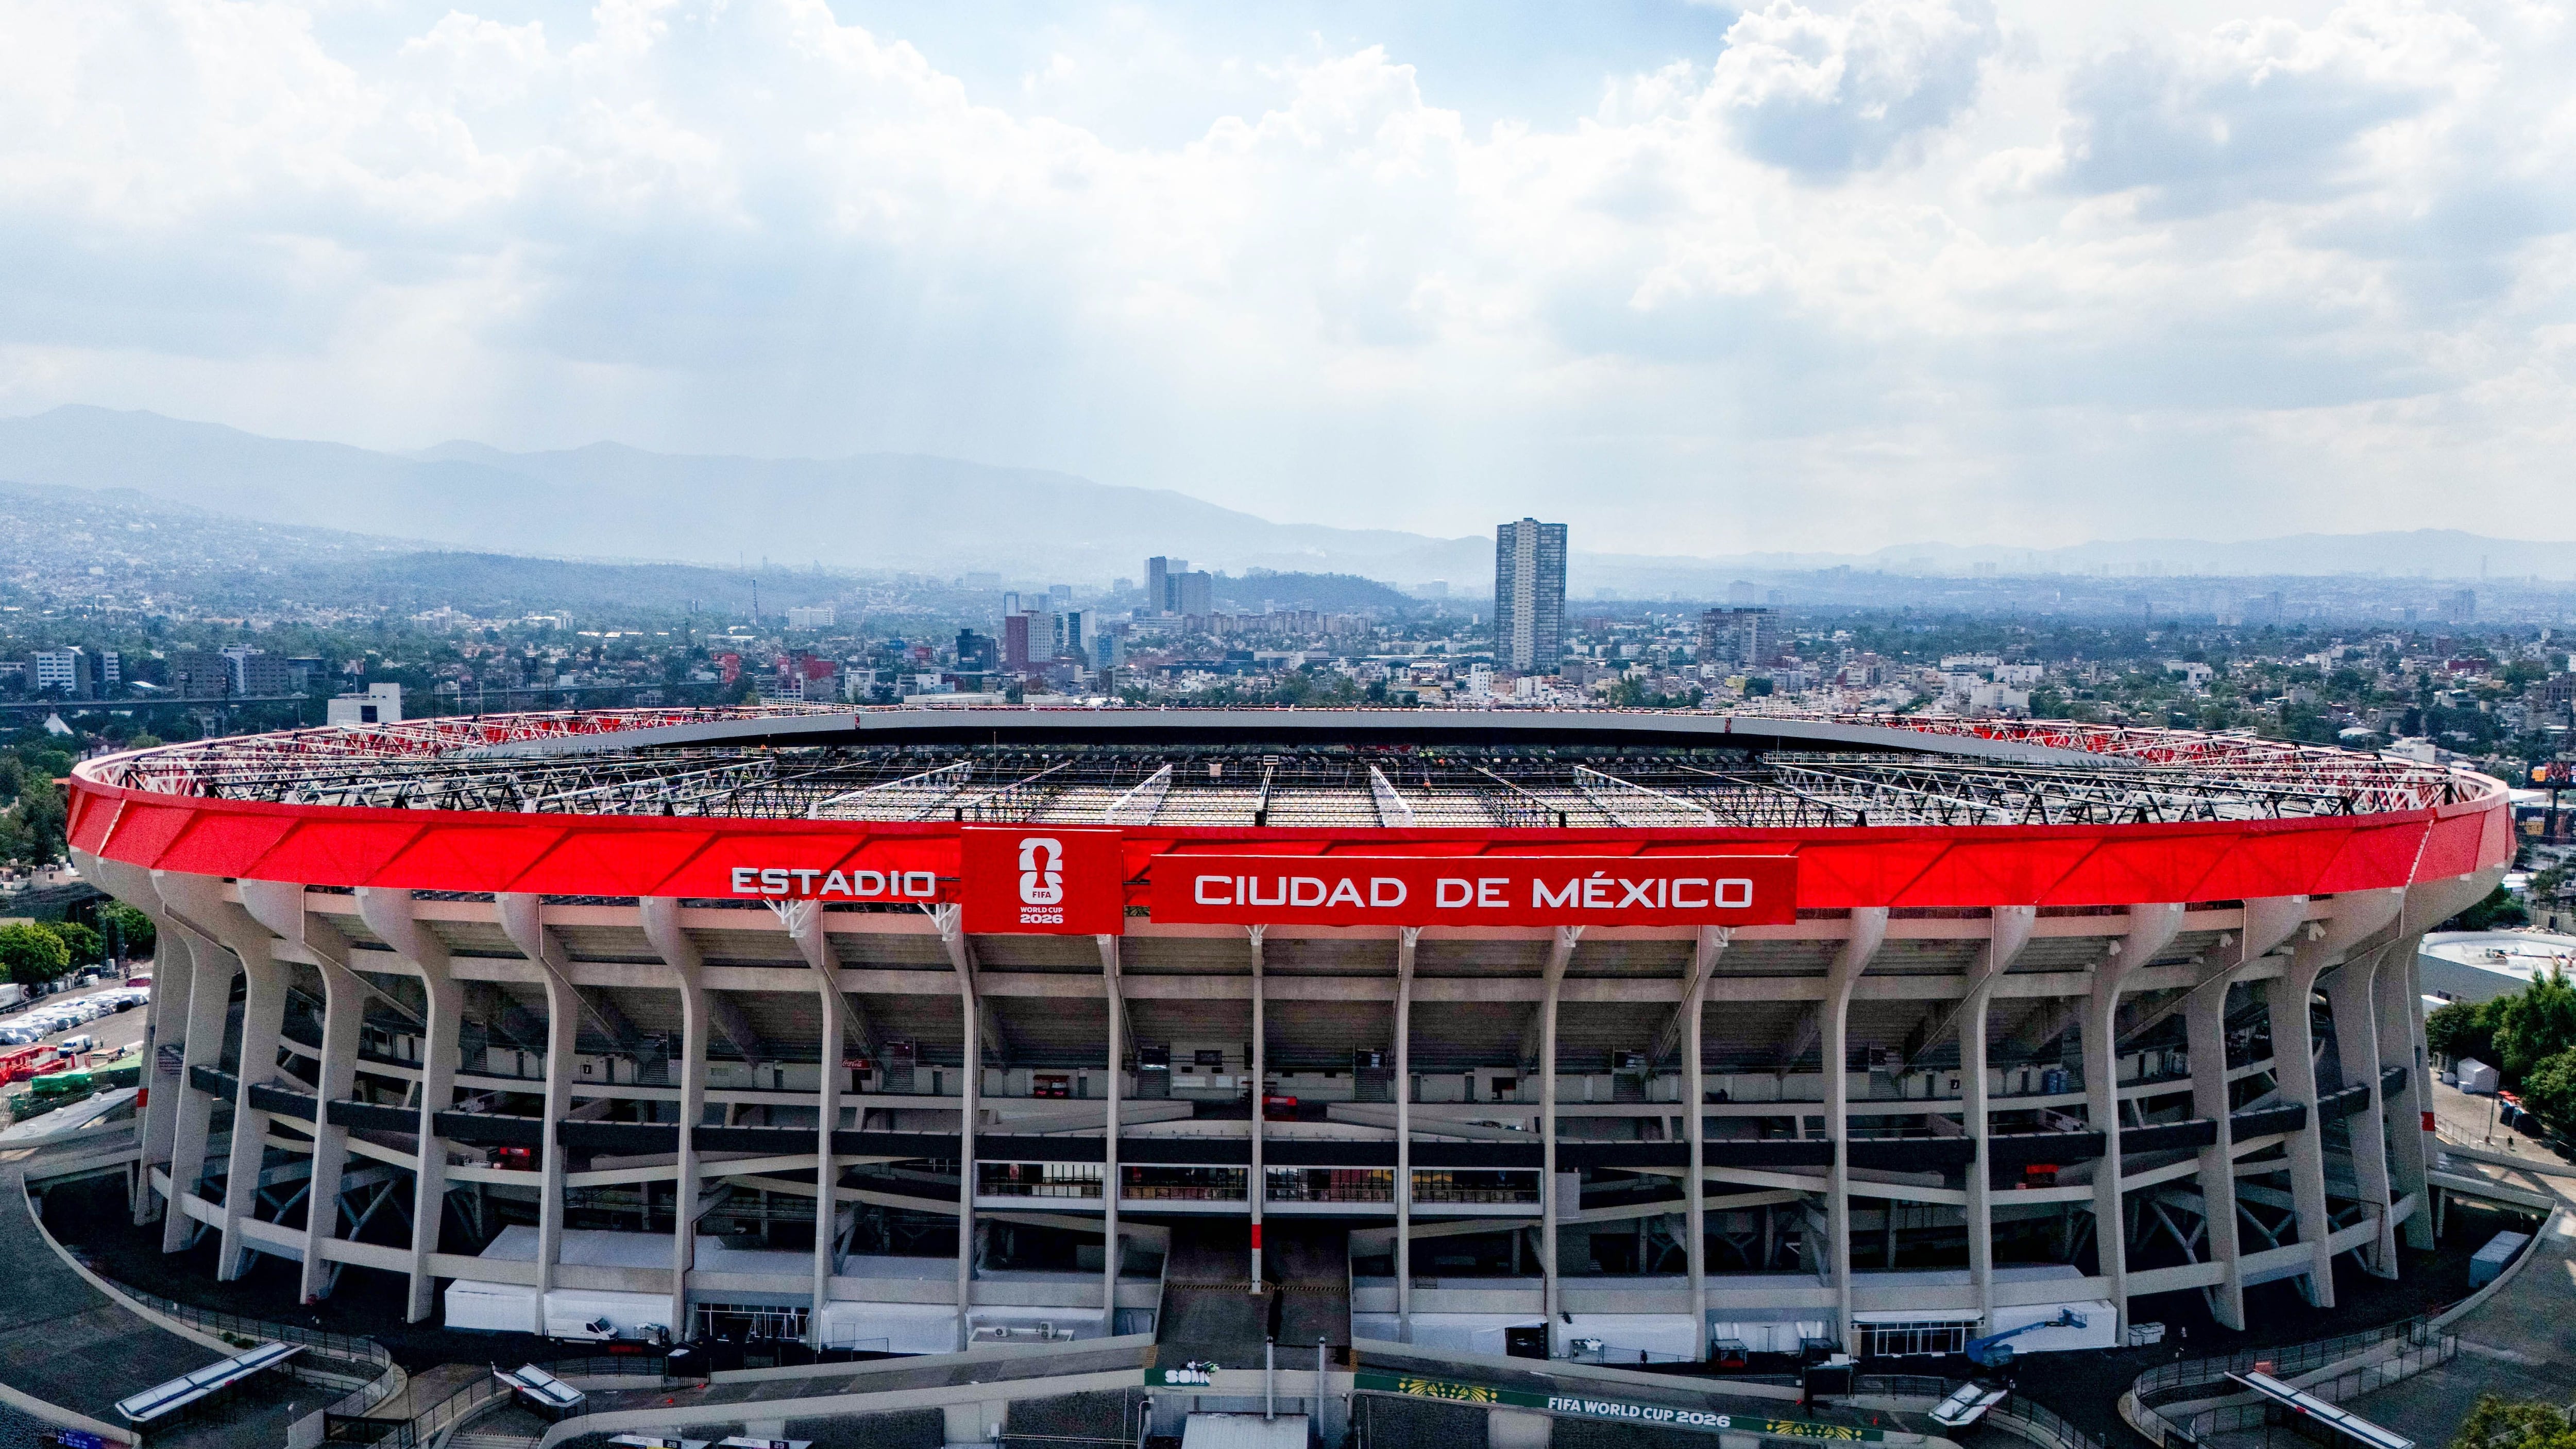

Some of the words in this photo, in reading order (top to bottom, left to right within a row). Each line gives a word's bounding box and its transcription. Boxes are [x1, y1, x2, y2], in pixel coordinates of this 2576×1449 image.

[732, 867, 936, 897] ESTADIO
[1195, 875, 1407, 907] CIUDAD
[1436, 878, 1509, 908] DE
[1532, 871, 1753, 908] MÉXICO
[1020, 913, 1063, 924] 2026
[1548, 1397, 1581, 1412] FIFA
[1584, 1400, 1640, 1418] WORLD
[1642, 1407, 1674, 1421] CUP
[1675, 1410, 1731, 1428] 2026
